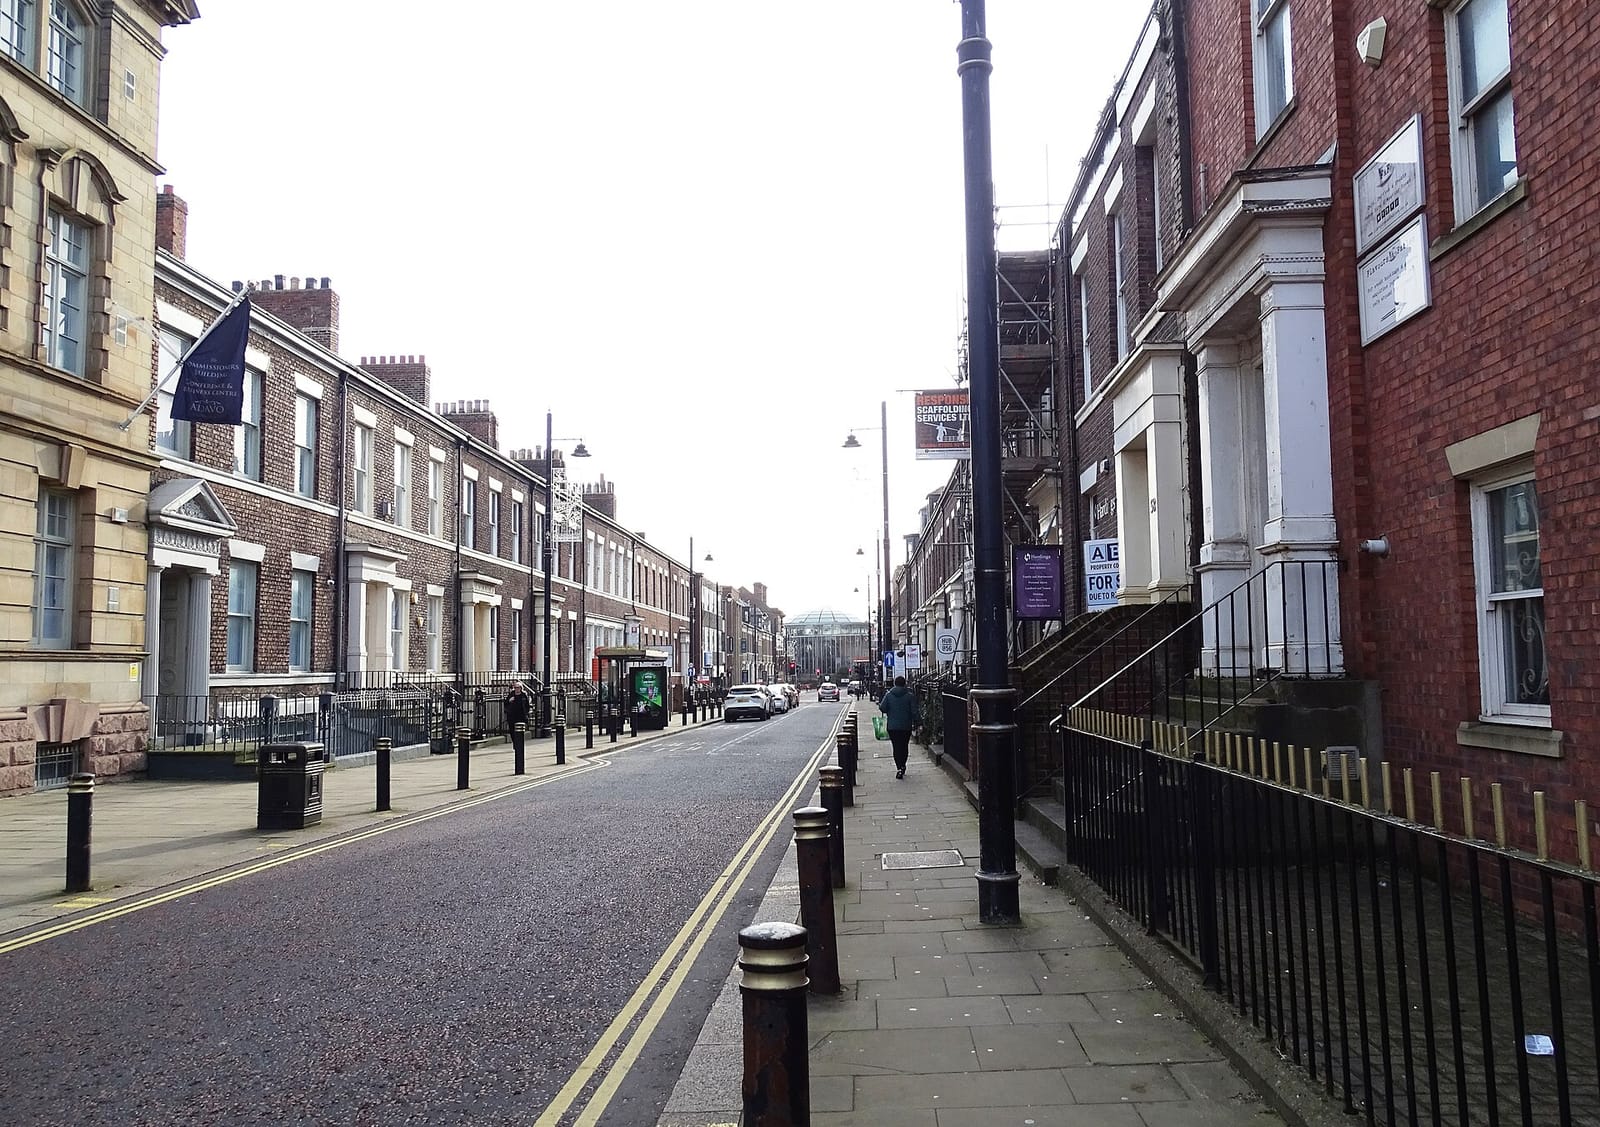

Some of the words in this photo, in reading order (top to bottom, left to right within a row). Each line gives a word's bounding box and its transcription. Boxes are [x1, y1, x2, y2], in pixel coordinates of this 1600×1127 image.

[187, 361, 240, 370] OMMISSIONERS
[916, 395, 969, 405] RESPONS
[917, 414, 957, 422] SERVICES
[1088, 575, 1112, 590] FOR
[1102, 592, 1110, 600] TO
